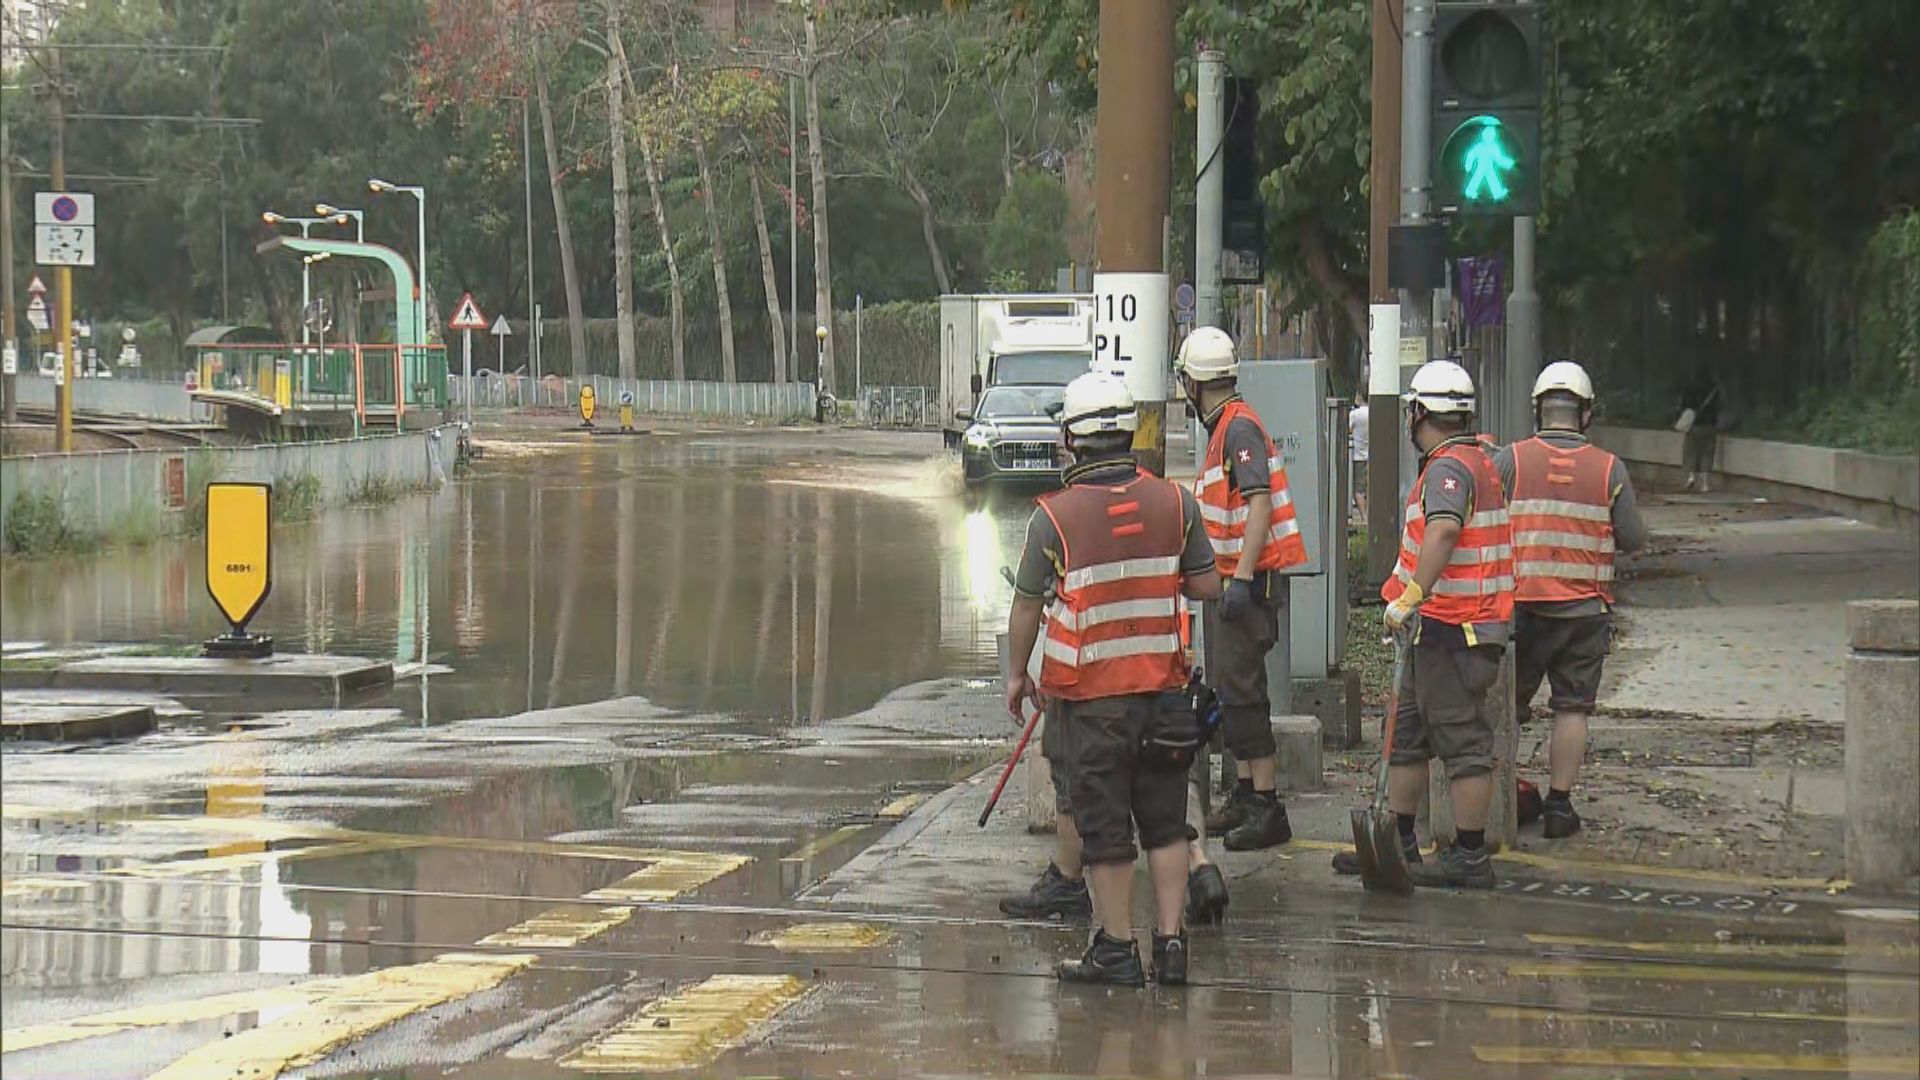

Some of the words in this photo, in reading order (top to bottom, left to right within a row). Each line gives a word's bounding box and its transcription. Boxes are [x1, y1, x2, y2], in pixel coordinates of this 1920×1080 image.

[74, 228, 83, 241] 7
[74, 250, 83, 263] 7
[1095, 334, 1132, 361] PL
[226, 564, 250, 573] 6891
